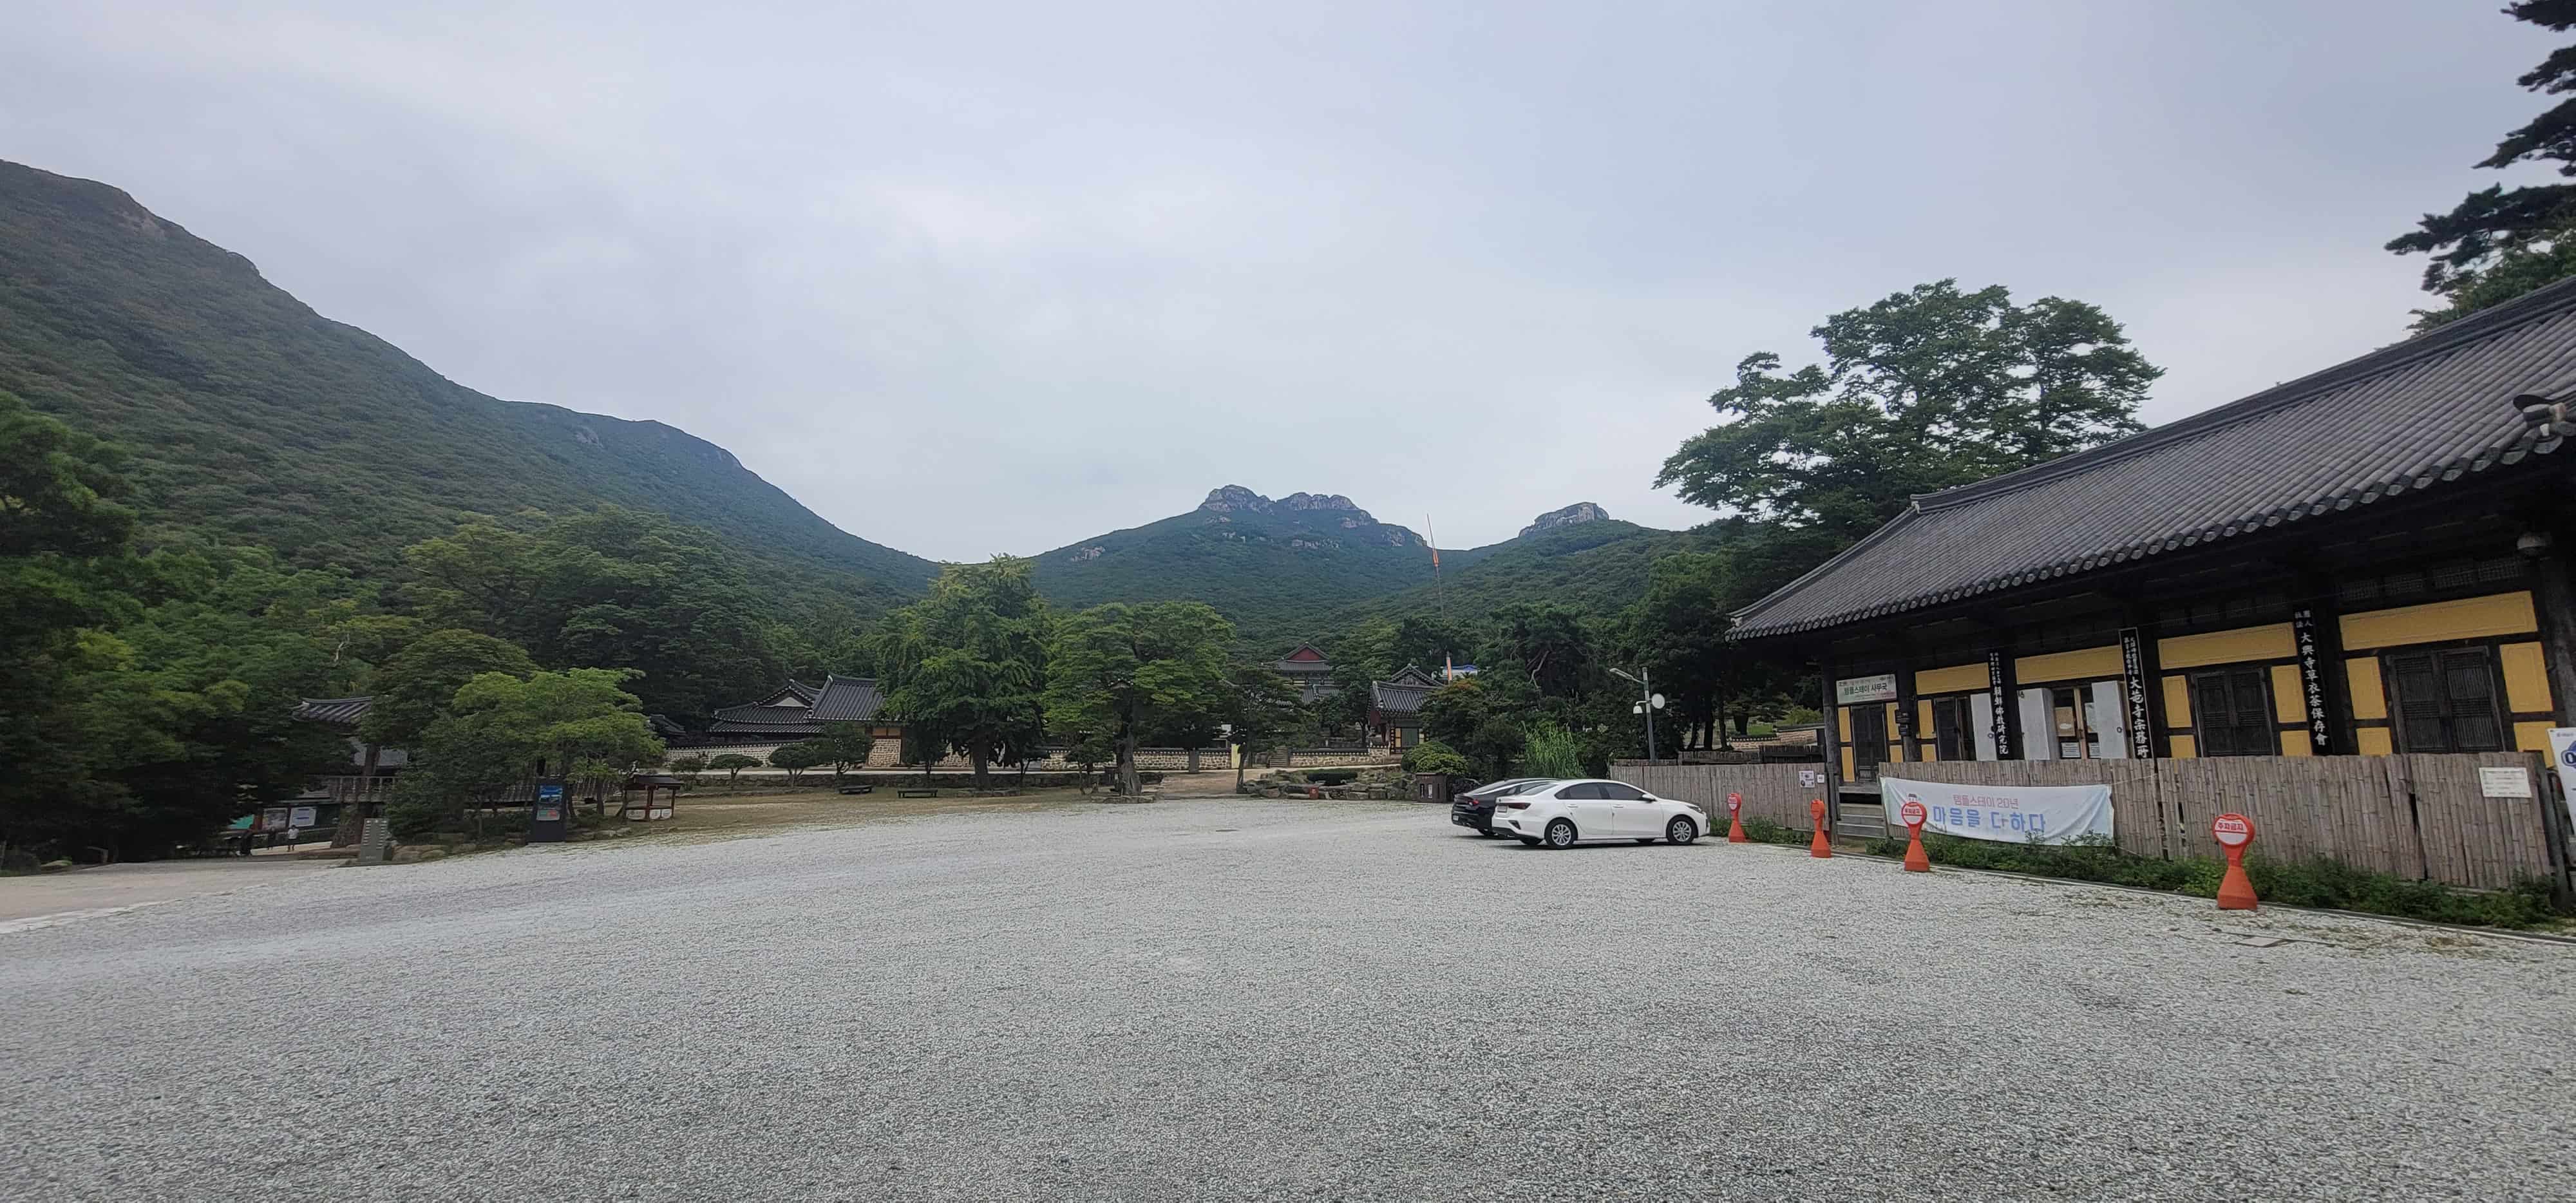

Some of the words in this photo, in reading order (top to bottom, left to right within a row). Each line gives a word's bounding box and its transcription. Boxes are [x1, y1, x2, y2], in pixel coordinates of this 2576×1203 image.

[1871, 683, 1888, 692] 사무국
[1953, 793, 1995, 808] 템플스테이
[1996, 798, 2019, 809] 20년
[1933, 806, 1980, 828] 마음을
